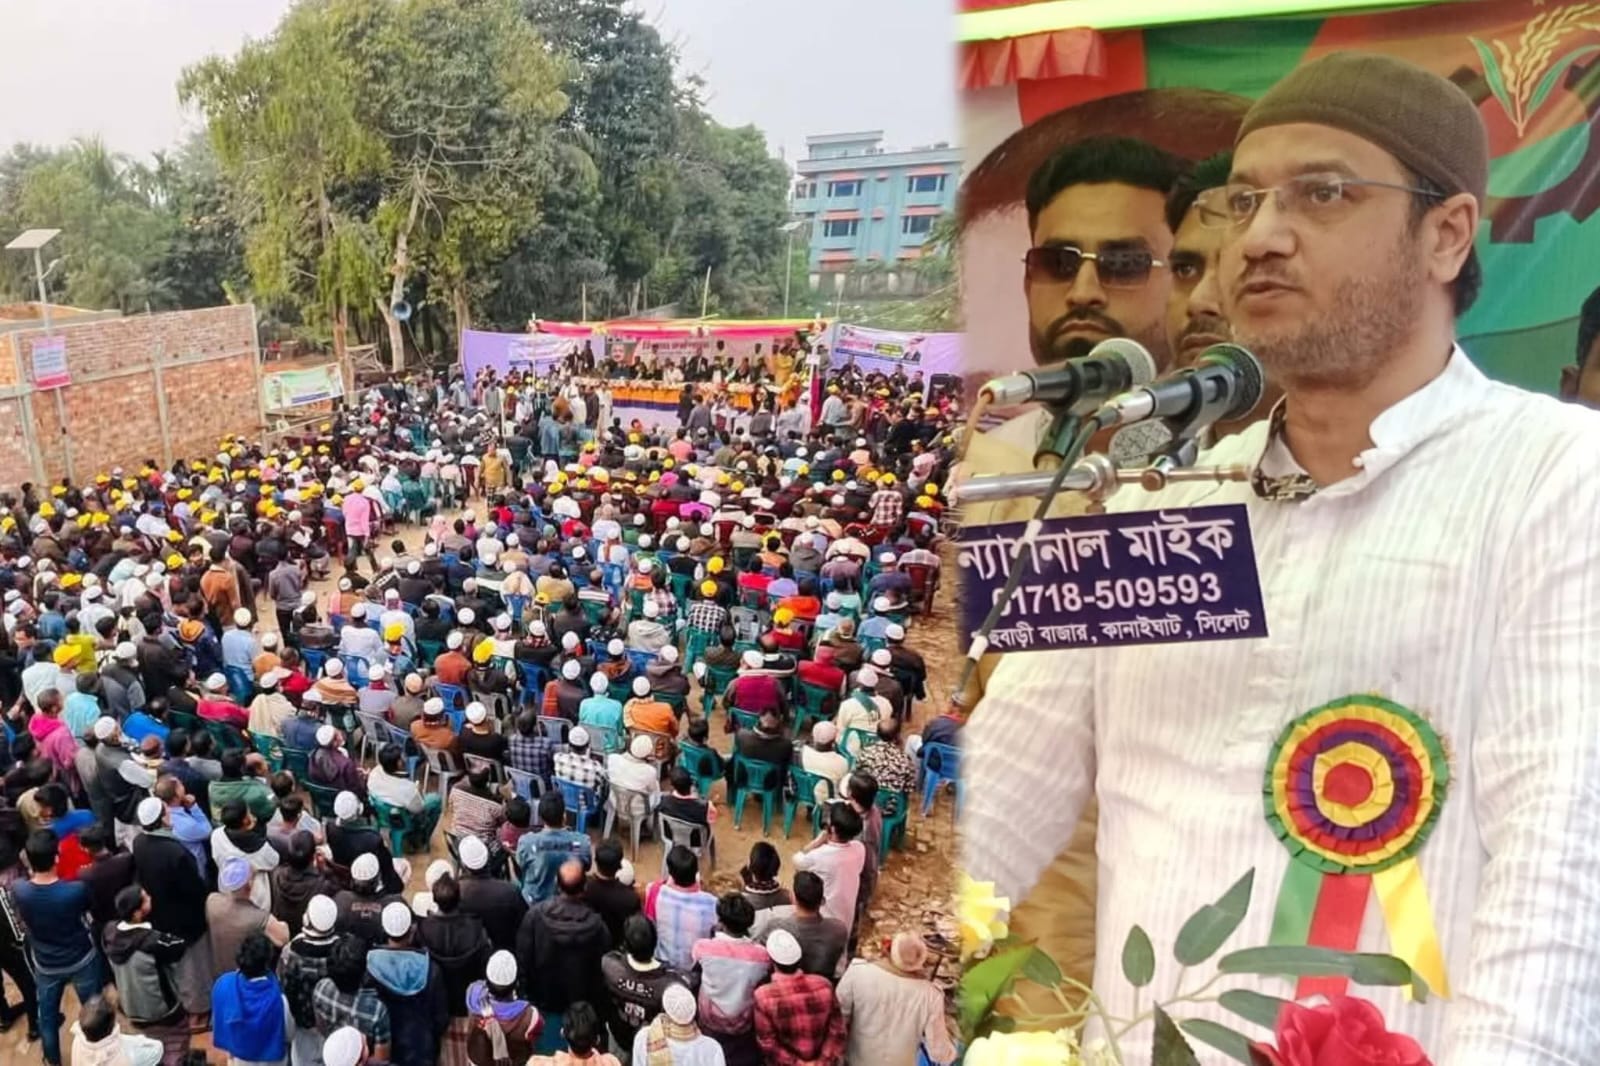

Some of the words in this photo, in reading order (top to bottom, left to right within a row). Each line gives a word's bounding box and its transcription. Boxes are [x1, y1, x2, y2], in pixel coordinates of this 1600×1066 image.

[1117, 510, 1235, 565] মাইক
[992, 572, 1222, 616] 01718-509593
[1194, 608, 1251, 634] সিলেট
